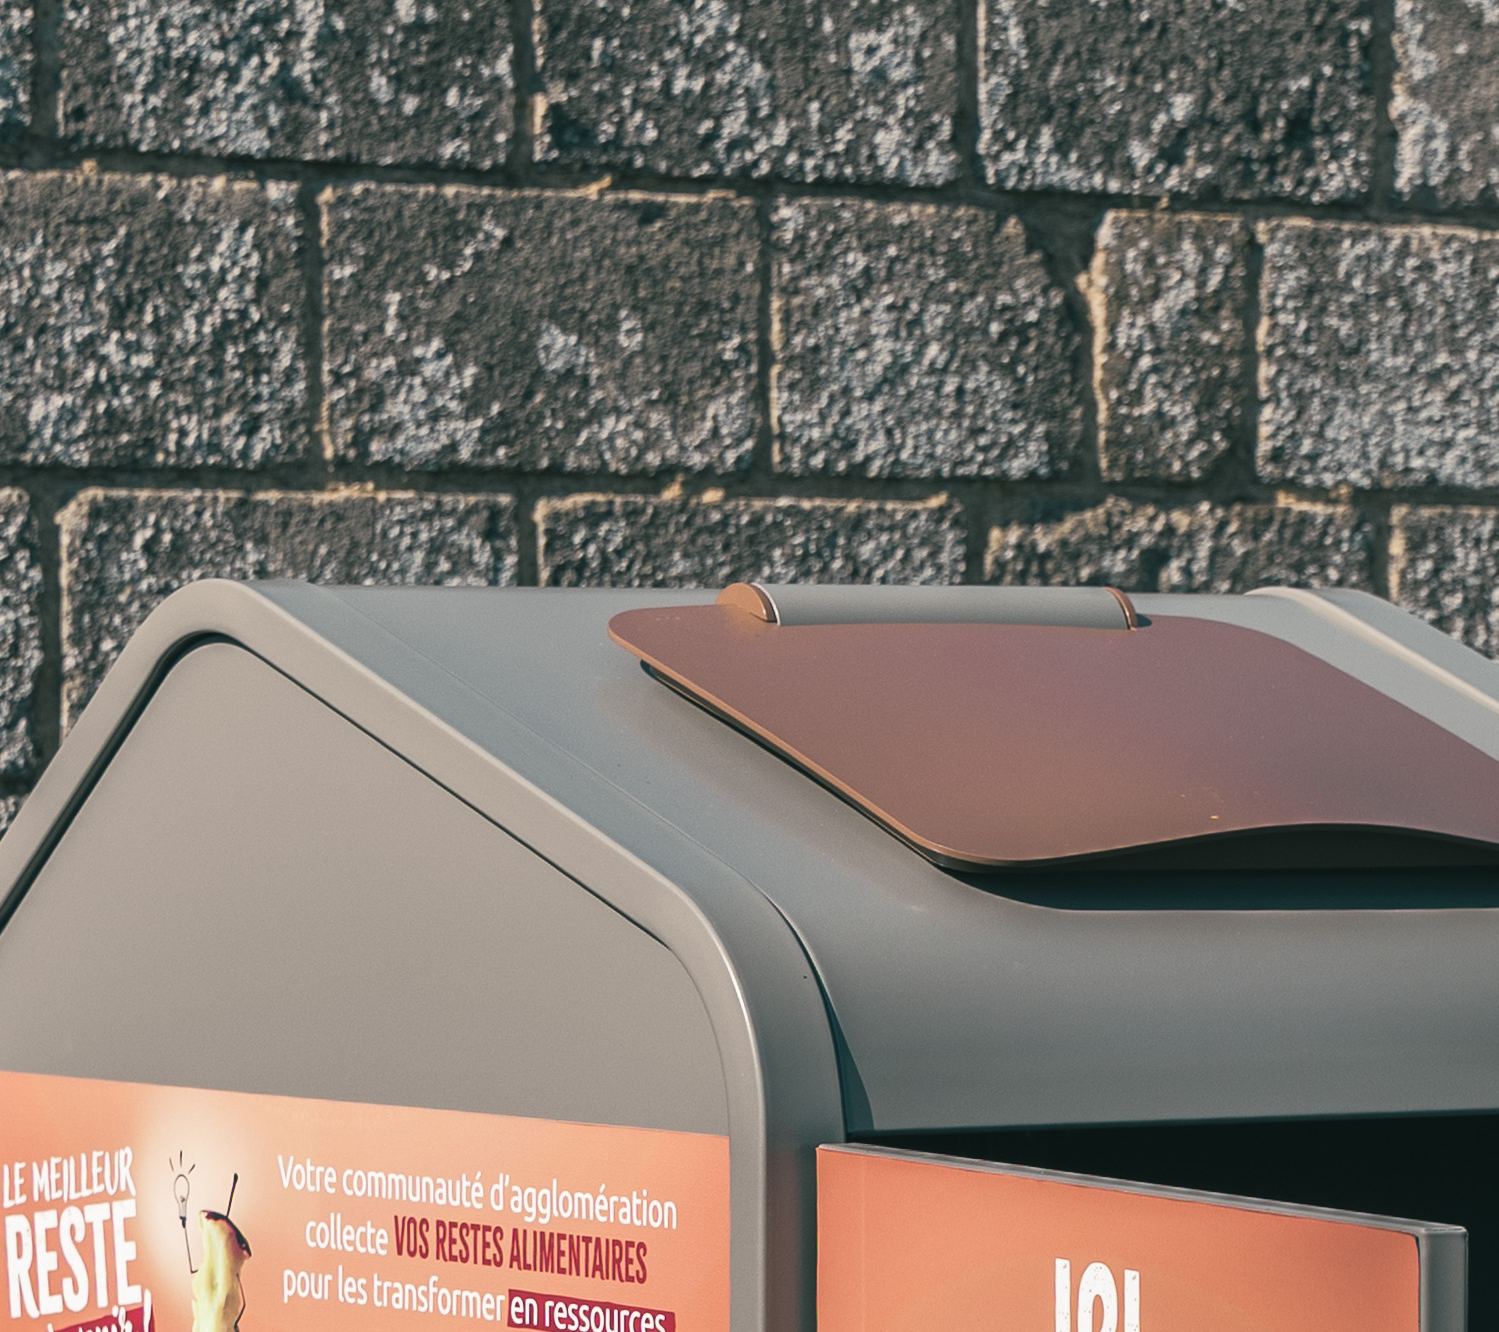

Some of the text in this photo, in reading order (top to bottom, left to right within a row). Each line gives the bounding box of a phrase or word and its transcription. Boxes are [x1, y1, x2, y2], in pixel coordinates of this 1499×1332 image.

[3, 1146, 136, 1208] LE MEILLEUR
[277, 1155, 677, 1230] Votre communauté d'agglomération
[5, 1199, 143, 1319] RESTE
[305, 1212, 647, 1285] collecte VOS RESTES ALIMENTAIRES
[283, 1269, 333, 1304] pour
[338, 1264, 367, 1305] les
[373, 1273, 506, 1322] transformer
[510, 1296, 538, 1326] en
